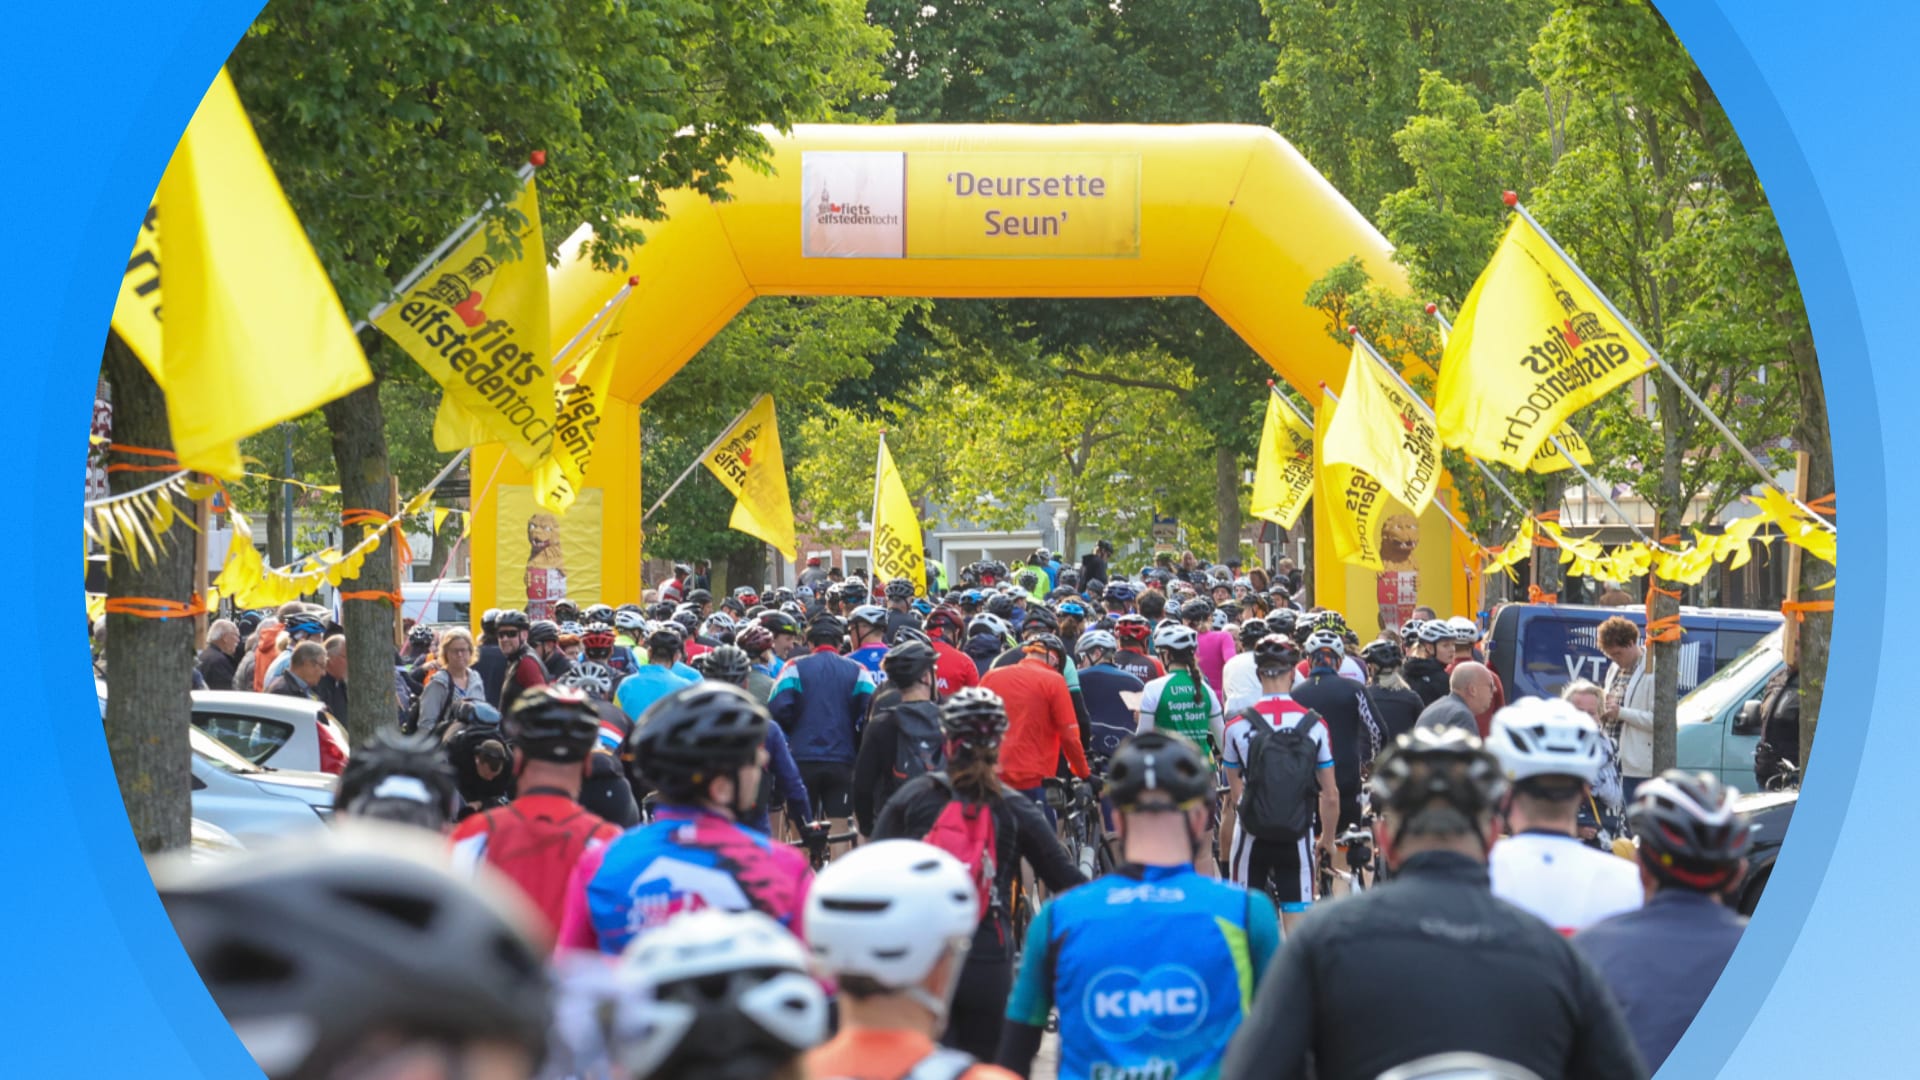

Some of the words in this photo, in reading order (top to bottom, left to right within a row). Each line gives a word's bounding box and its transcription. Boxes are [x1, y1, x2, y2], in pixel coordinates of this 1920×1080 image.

[817, 213, 898, 225] elfstedentocht
[841, 202, 871, 215] fiets
[984, 209, 1068, 236] Seun’
[470, 318, 545, 388] fiets
[878, 523, 922, 570] fiets
[1095, 987, 1198, 1019] KMC
